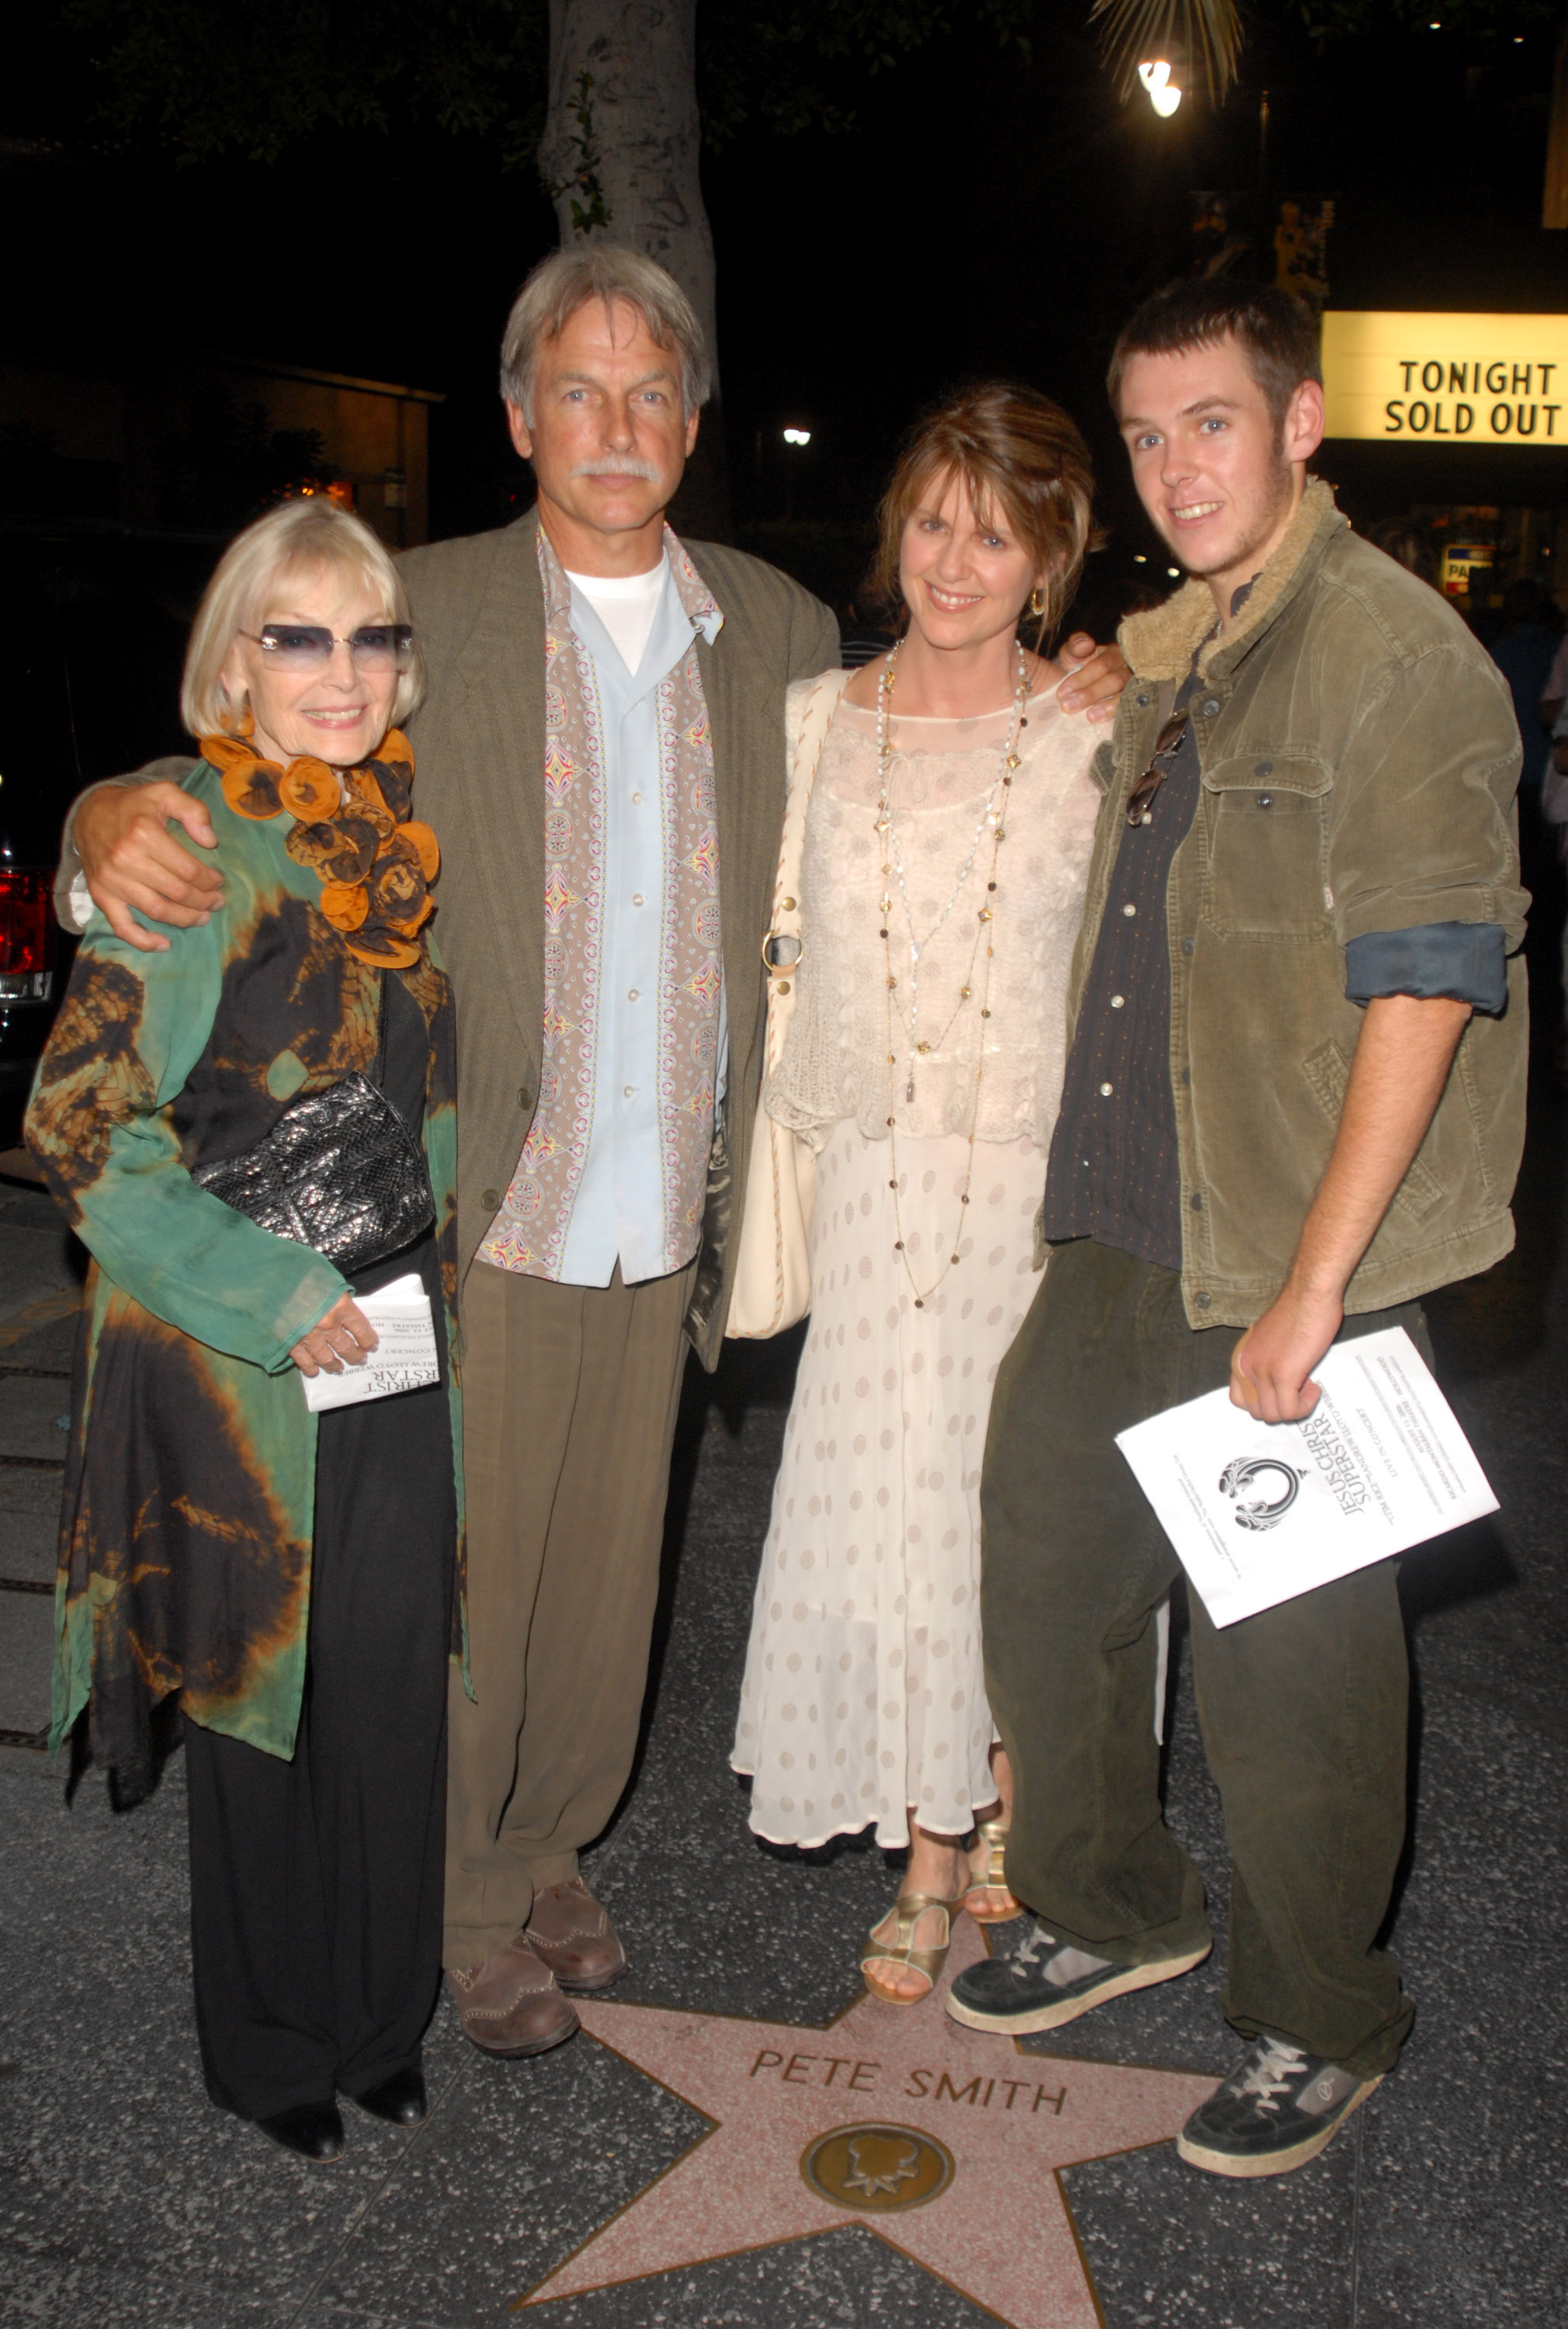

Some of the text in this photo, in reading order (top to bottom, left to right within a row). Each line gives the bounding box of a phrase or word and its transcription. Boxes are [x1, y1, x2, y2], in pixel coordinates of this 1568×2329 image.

[1400, 360, 1557, 395] TONIGHT
[1385, 400, 1562, 436] SOLD OUT
[1375, 1354, 1403, 1397] HOLLYWOOD
[1330, 1408, 1351, 1438] LLOYD
[1400, 1398, 1421, 1428] THEATRE
[1345, 1435, 1371, 1475] ANDREW
[1355, 1405, 1398, 1478] LIVE IN CONCERT
[1407, 1426, 1425, 1455] AUGUST
[1294, 1414, 1363, 1515] JESUS CHRIS
[1313, 1413, 1370, 1505] SUPERSTAR
[1369, 1480, 1385, 1501] RICE
[1436, 1468, 1458, 1501] RICARDO
[1379, 1499, 1393, 1517] TIM
[750, 2050, 1067, 2116] PETE SMITH
